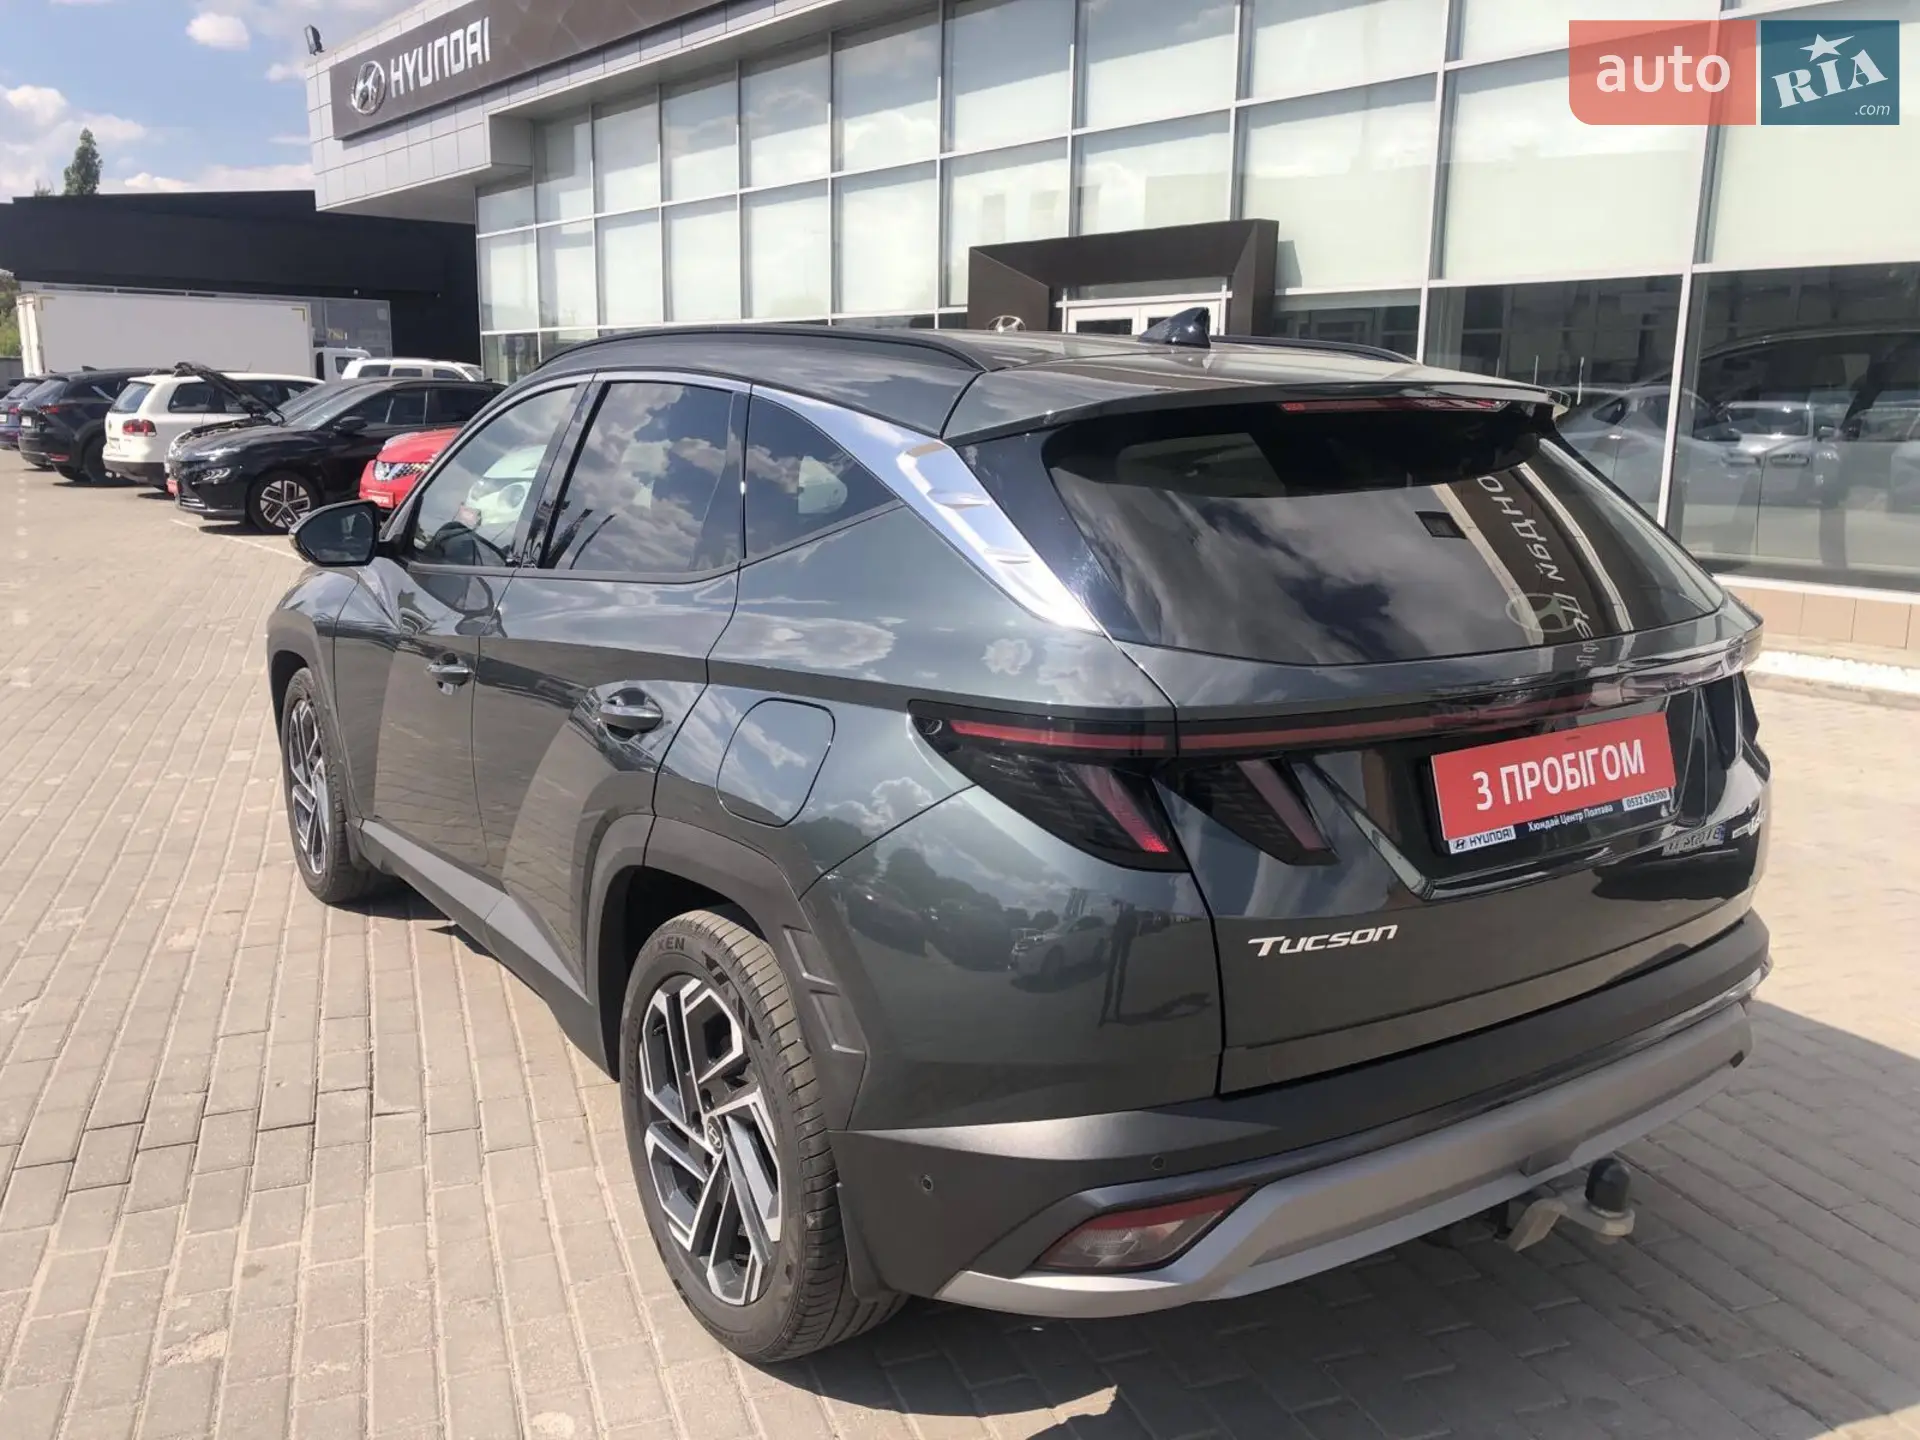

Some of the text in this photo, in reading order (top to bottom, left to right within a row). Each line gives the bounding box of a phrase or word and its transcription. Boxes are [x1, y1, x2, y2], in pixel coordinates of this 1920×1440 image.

[390, 16, 490, 98] HYUNDAI
[1500, 739, 1645, 804] ПРОБІГОМ
[1470, 827, 1514, 847] HYUNDAI
[1560, 810, 1583, 827] Центр
